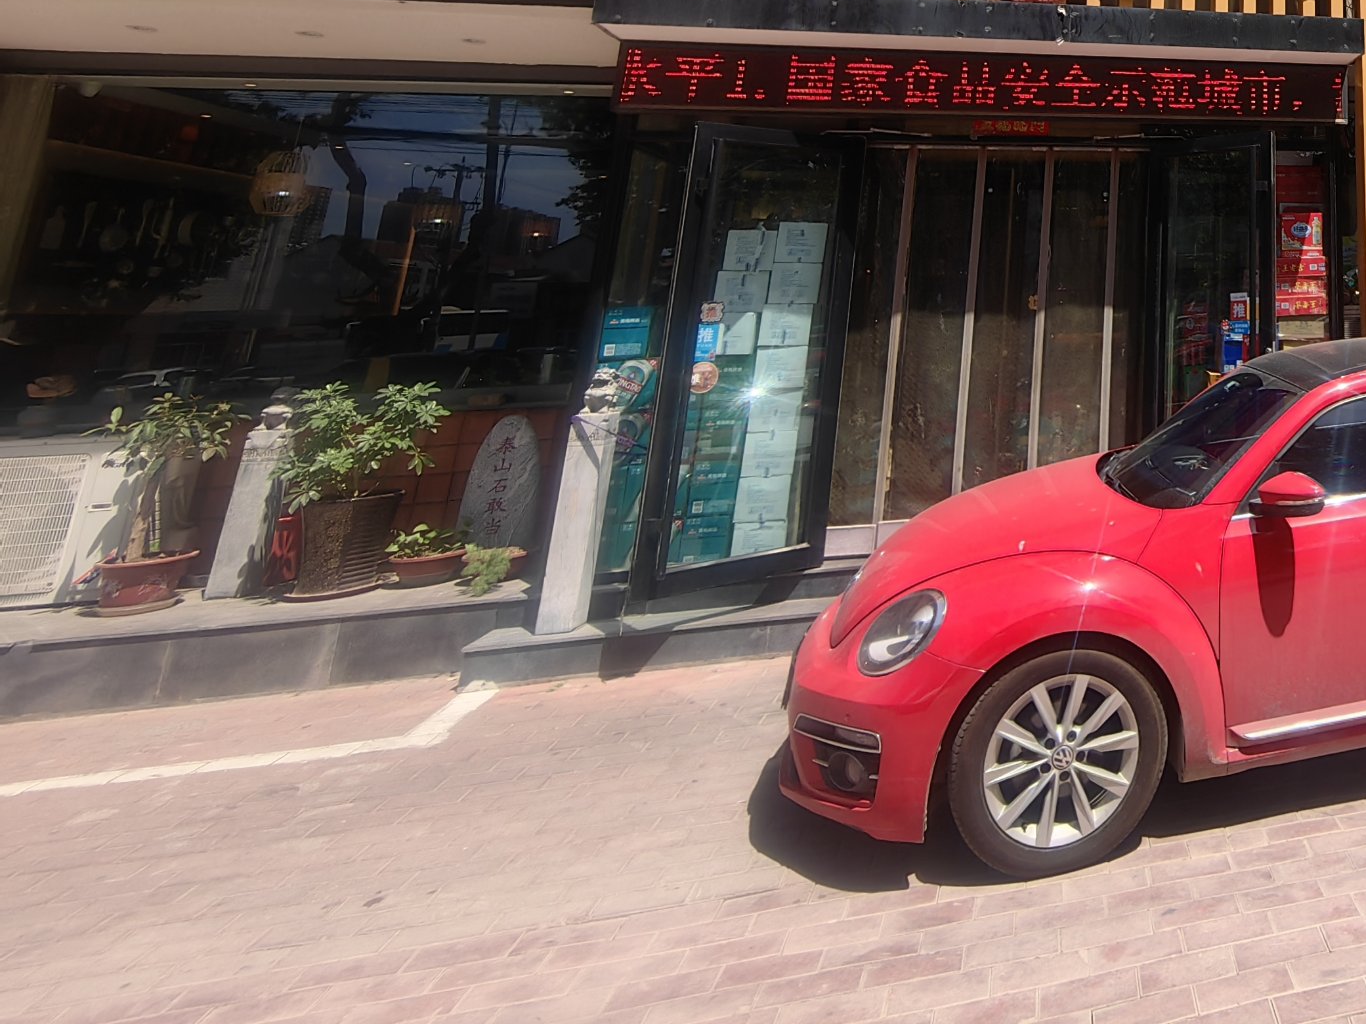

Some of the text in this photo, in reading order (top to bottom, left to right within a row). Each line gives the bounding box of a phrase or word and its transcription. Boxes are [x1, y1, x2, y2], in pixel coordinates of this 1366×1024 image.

[484, 435, 517, 536] 泰山石敢当
